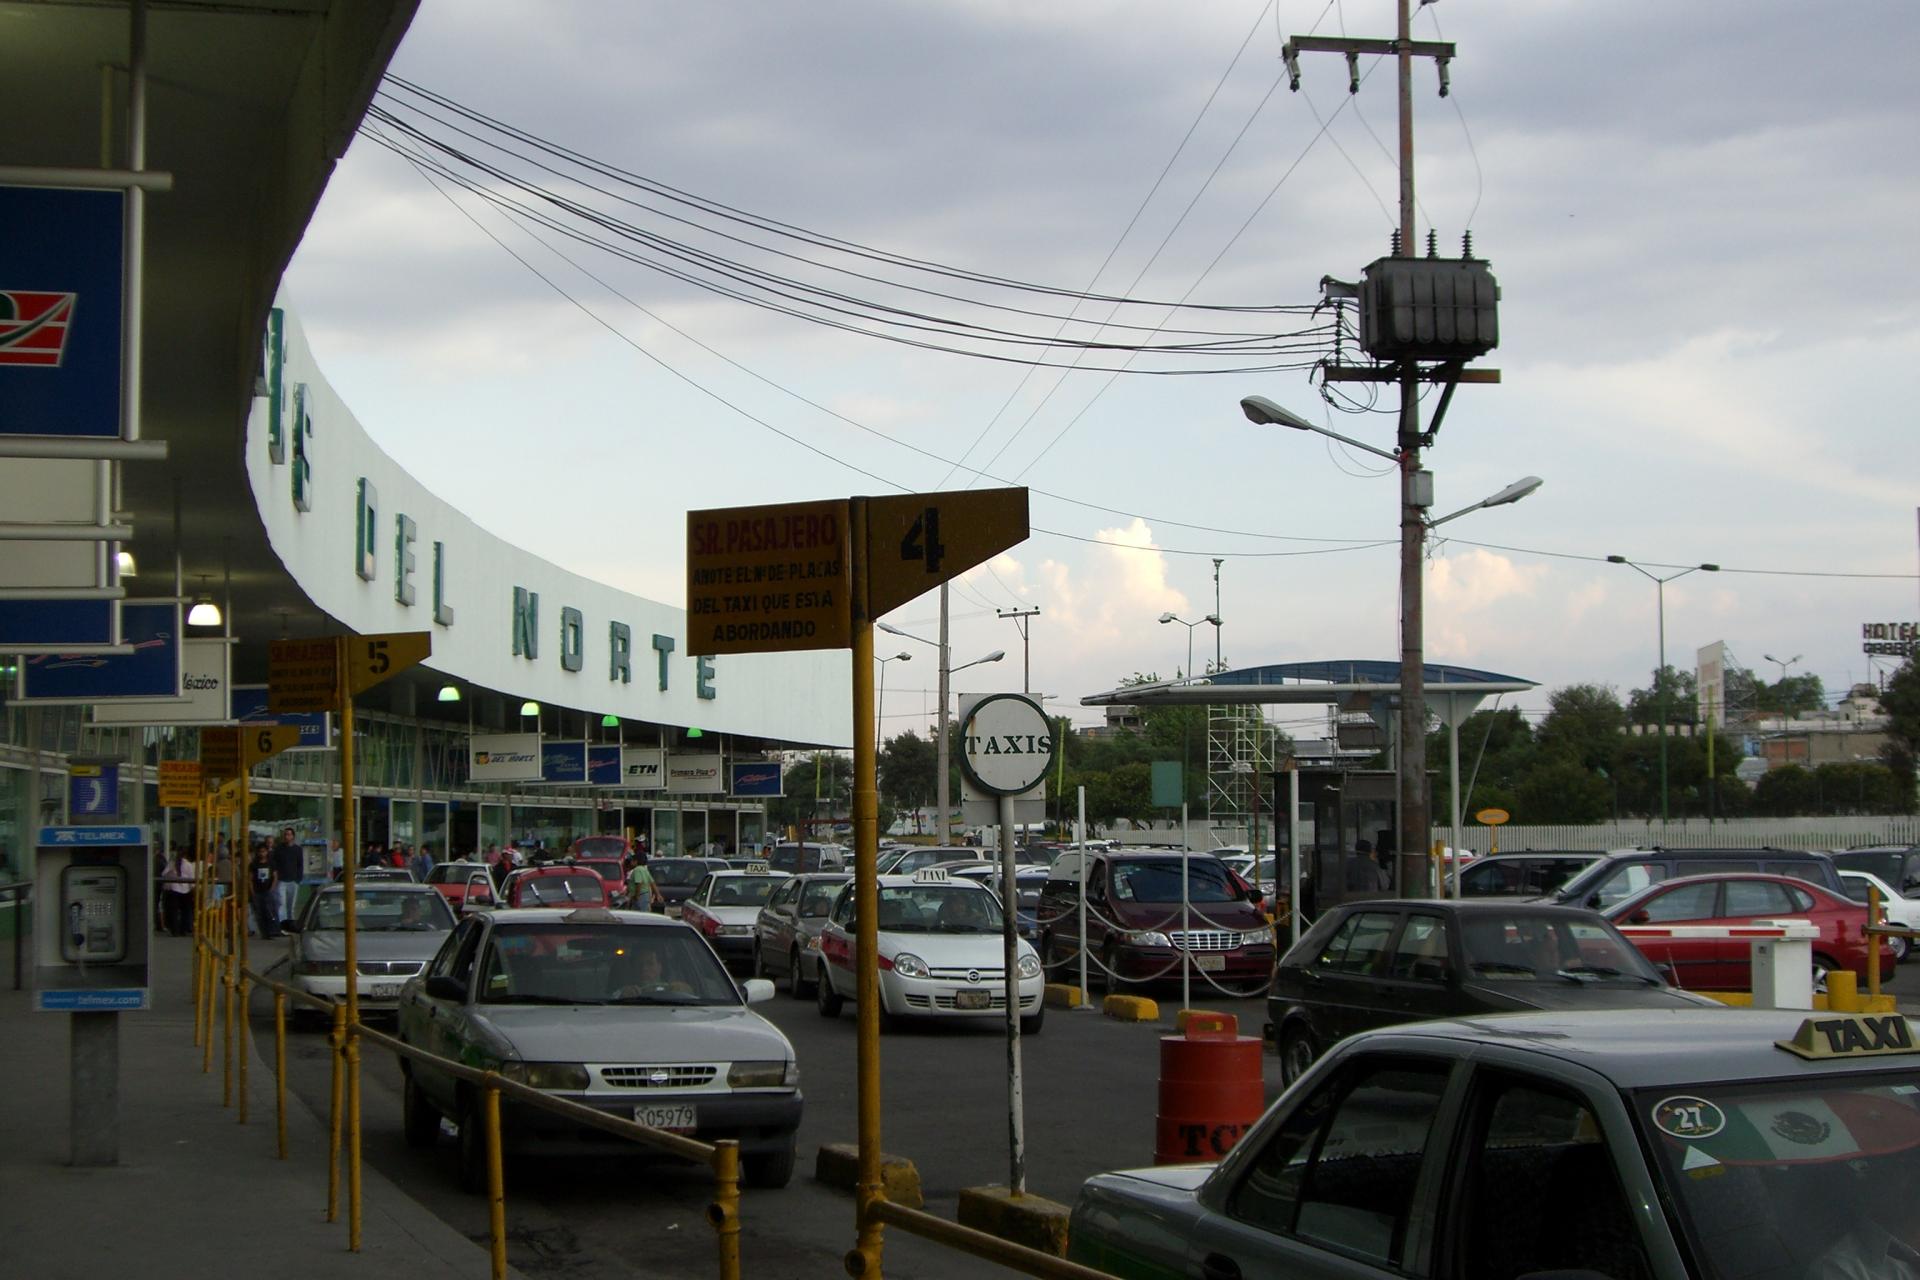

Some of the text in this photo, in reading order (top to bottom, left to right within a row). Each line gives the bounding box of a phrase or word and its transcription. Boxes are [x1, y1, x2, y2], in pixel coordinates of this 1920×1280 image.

[727, 513, 838, 554] PASAJERO
[900, 507, 945, 573] 4
[693, 566, 732, 586] ANOTE
[736, 565, 752, 584] EL
[768, 563, 784, 582] DE
[356, 477, 454, 627] DEL
[512, 586, 716, 700] NORTE
[693, 597, 720, 615] DEL
[723, 593, 757, 613] TAXI
[762, 593, 790, 614] QUE
[712, 620, 817, 642] ABORDANDO
[368, 640, 390, 674] 5
[183, 672, 218, 690] éxico
[257, 730, 272, 753] 6
[963, 735, 1052, 754] TAXIS
[629, 765, 658, 774] ETN
[77, 831, 125, 841] TELMEX
[750, 864, 767, 872] TAXI
[922, 870, 945, 881] TAXI
[78, 995, 140, 1005] telmex.com
[1815, 1015, 1912, 1053] TAXI
[1673, 1106, 1703, 1129] 27
[1178, 1124, 1253, 1157] TC
